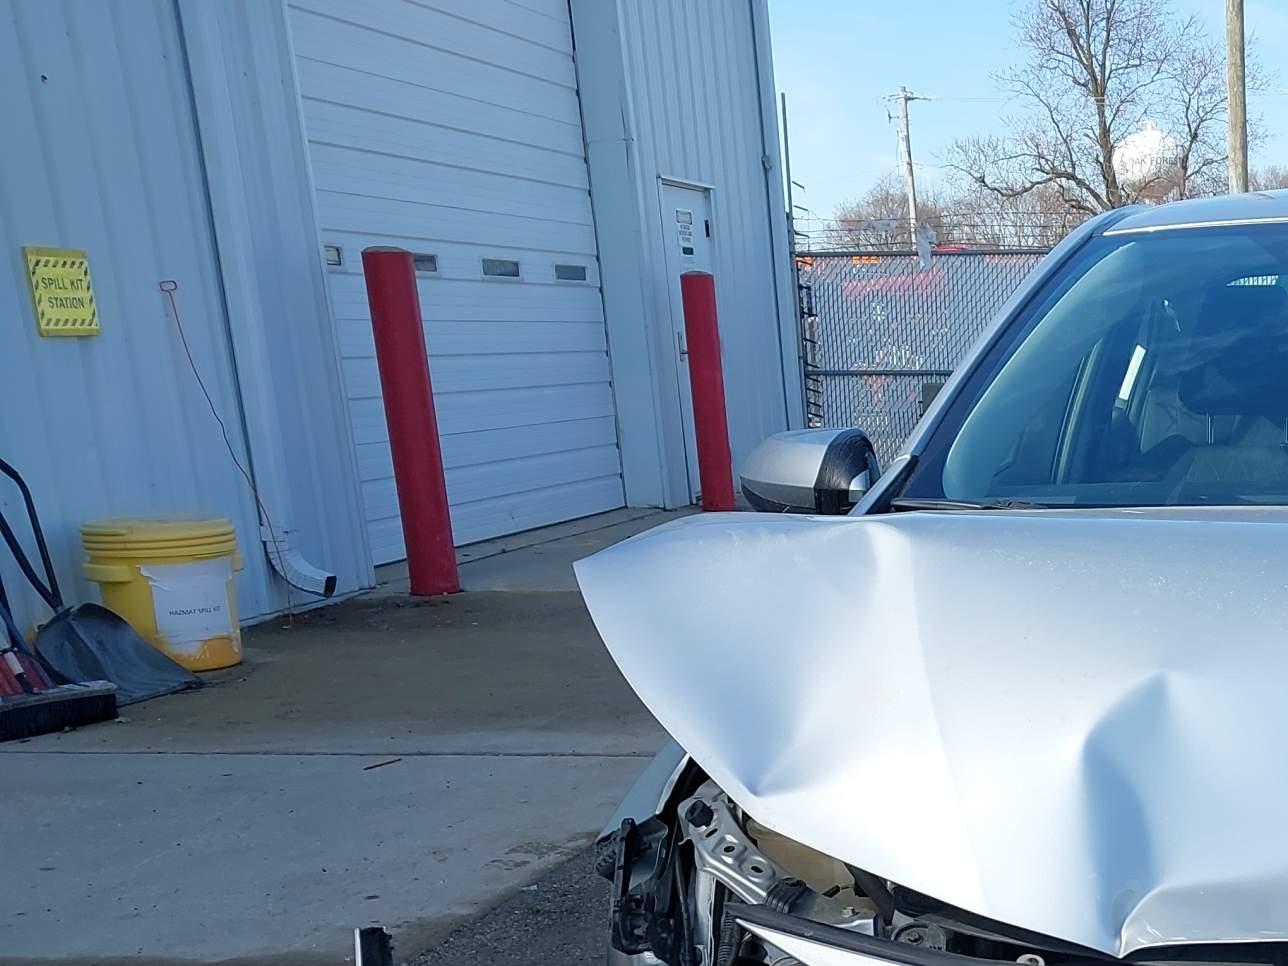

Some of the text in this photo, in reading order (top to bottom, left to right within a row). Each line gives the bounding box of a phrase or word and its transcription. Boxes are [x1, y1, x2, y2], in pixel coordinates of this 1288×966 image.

[41, 277, 84, 291] SPILL KIT
[47, 296, 86, 310] STATION
[169, 608, 197, 616] HAZMAT
